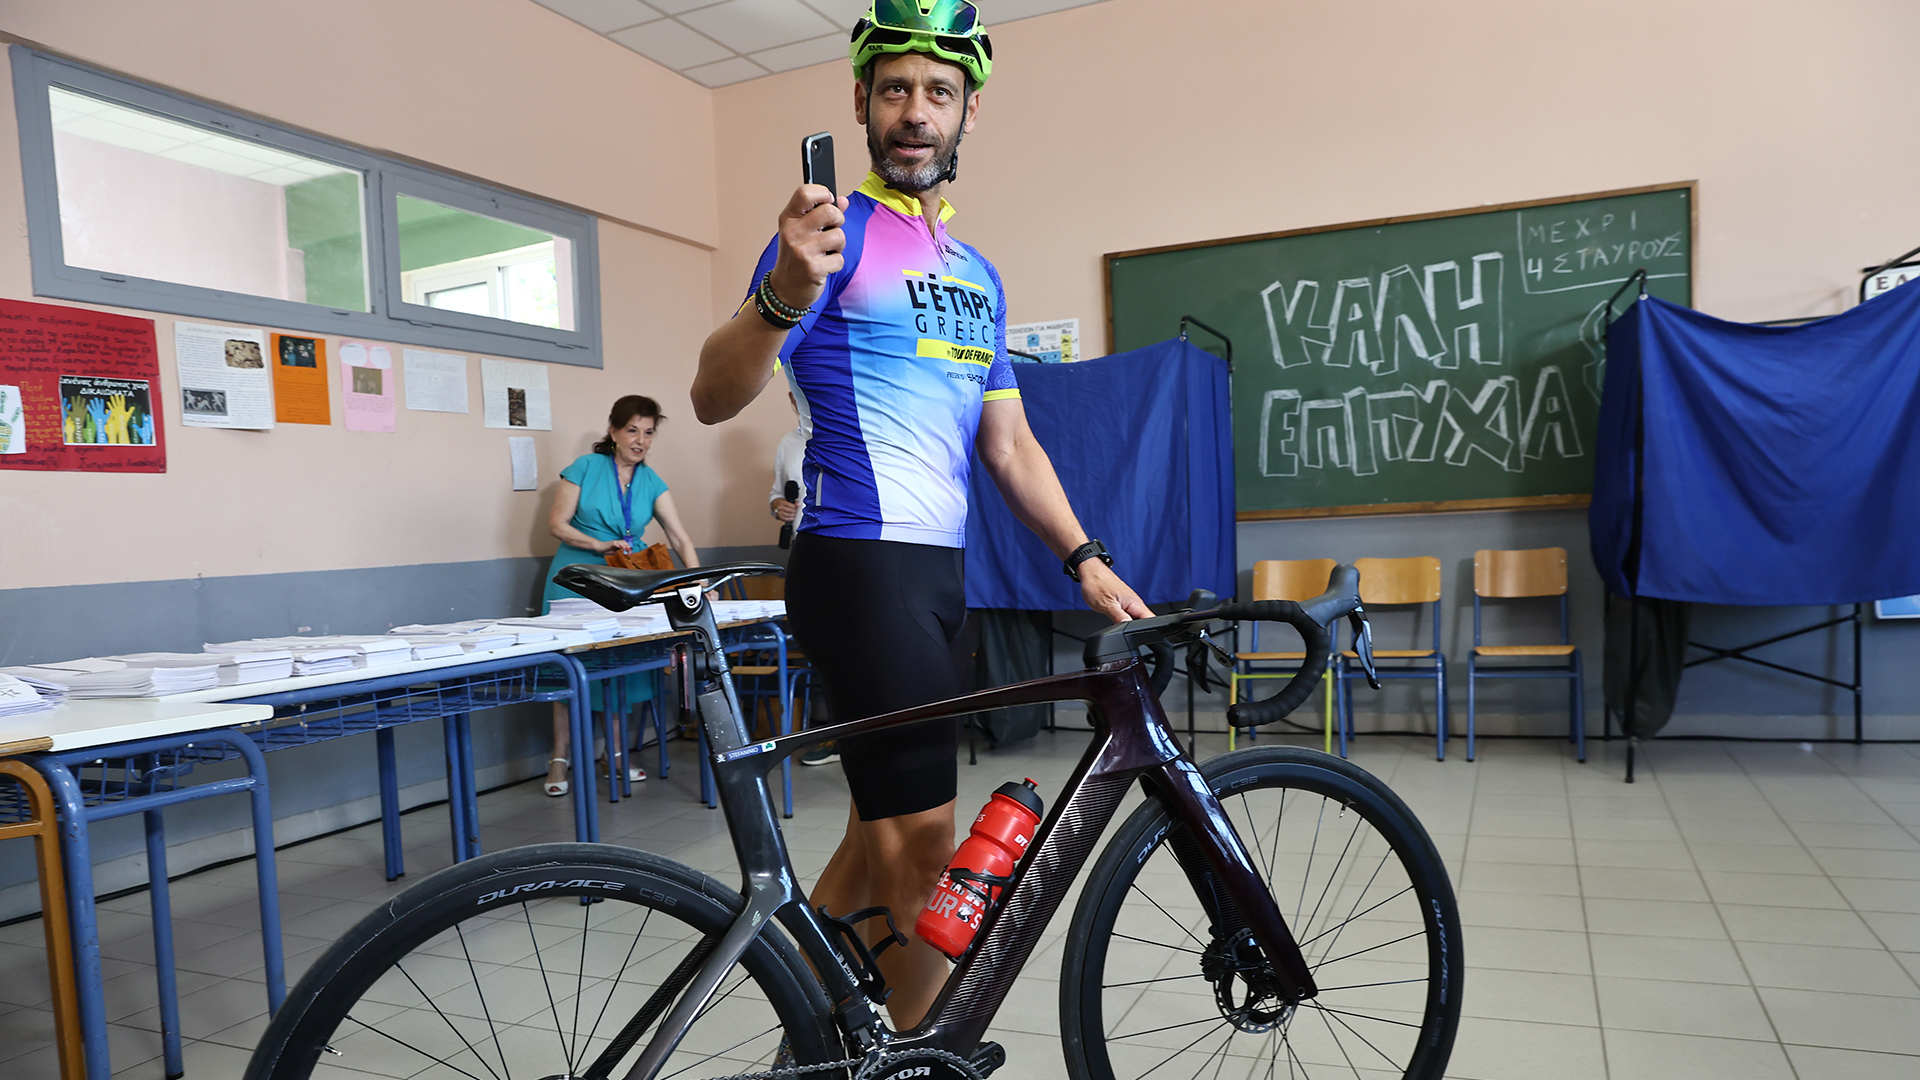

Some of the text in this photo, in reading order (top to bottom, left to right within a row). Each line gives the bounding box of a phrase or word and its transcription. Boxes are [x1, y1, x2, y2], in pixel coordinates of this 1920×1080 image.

[1527, 210, 1637, 244] ΜΕΧΡΙ
[1527, 232, 1684, 281] 4 ΣΤΑΥΡΟΥΣ
[1260, 252, 1504, 376] ΚΑΛΗ
[1259, 365, 1584, 478] ΕΠΙΤΥΧΙΑ
[476, 879, 626, 905] DURA-ACE
